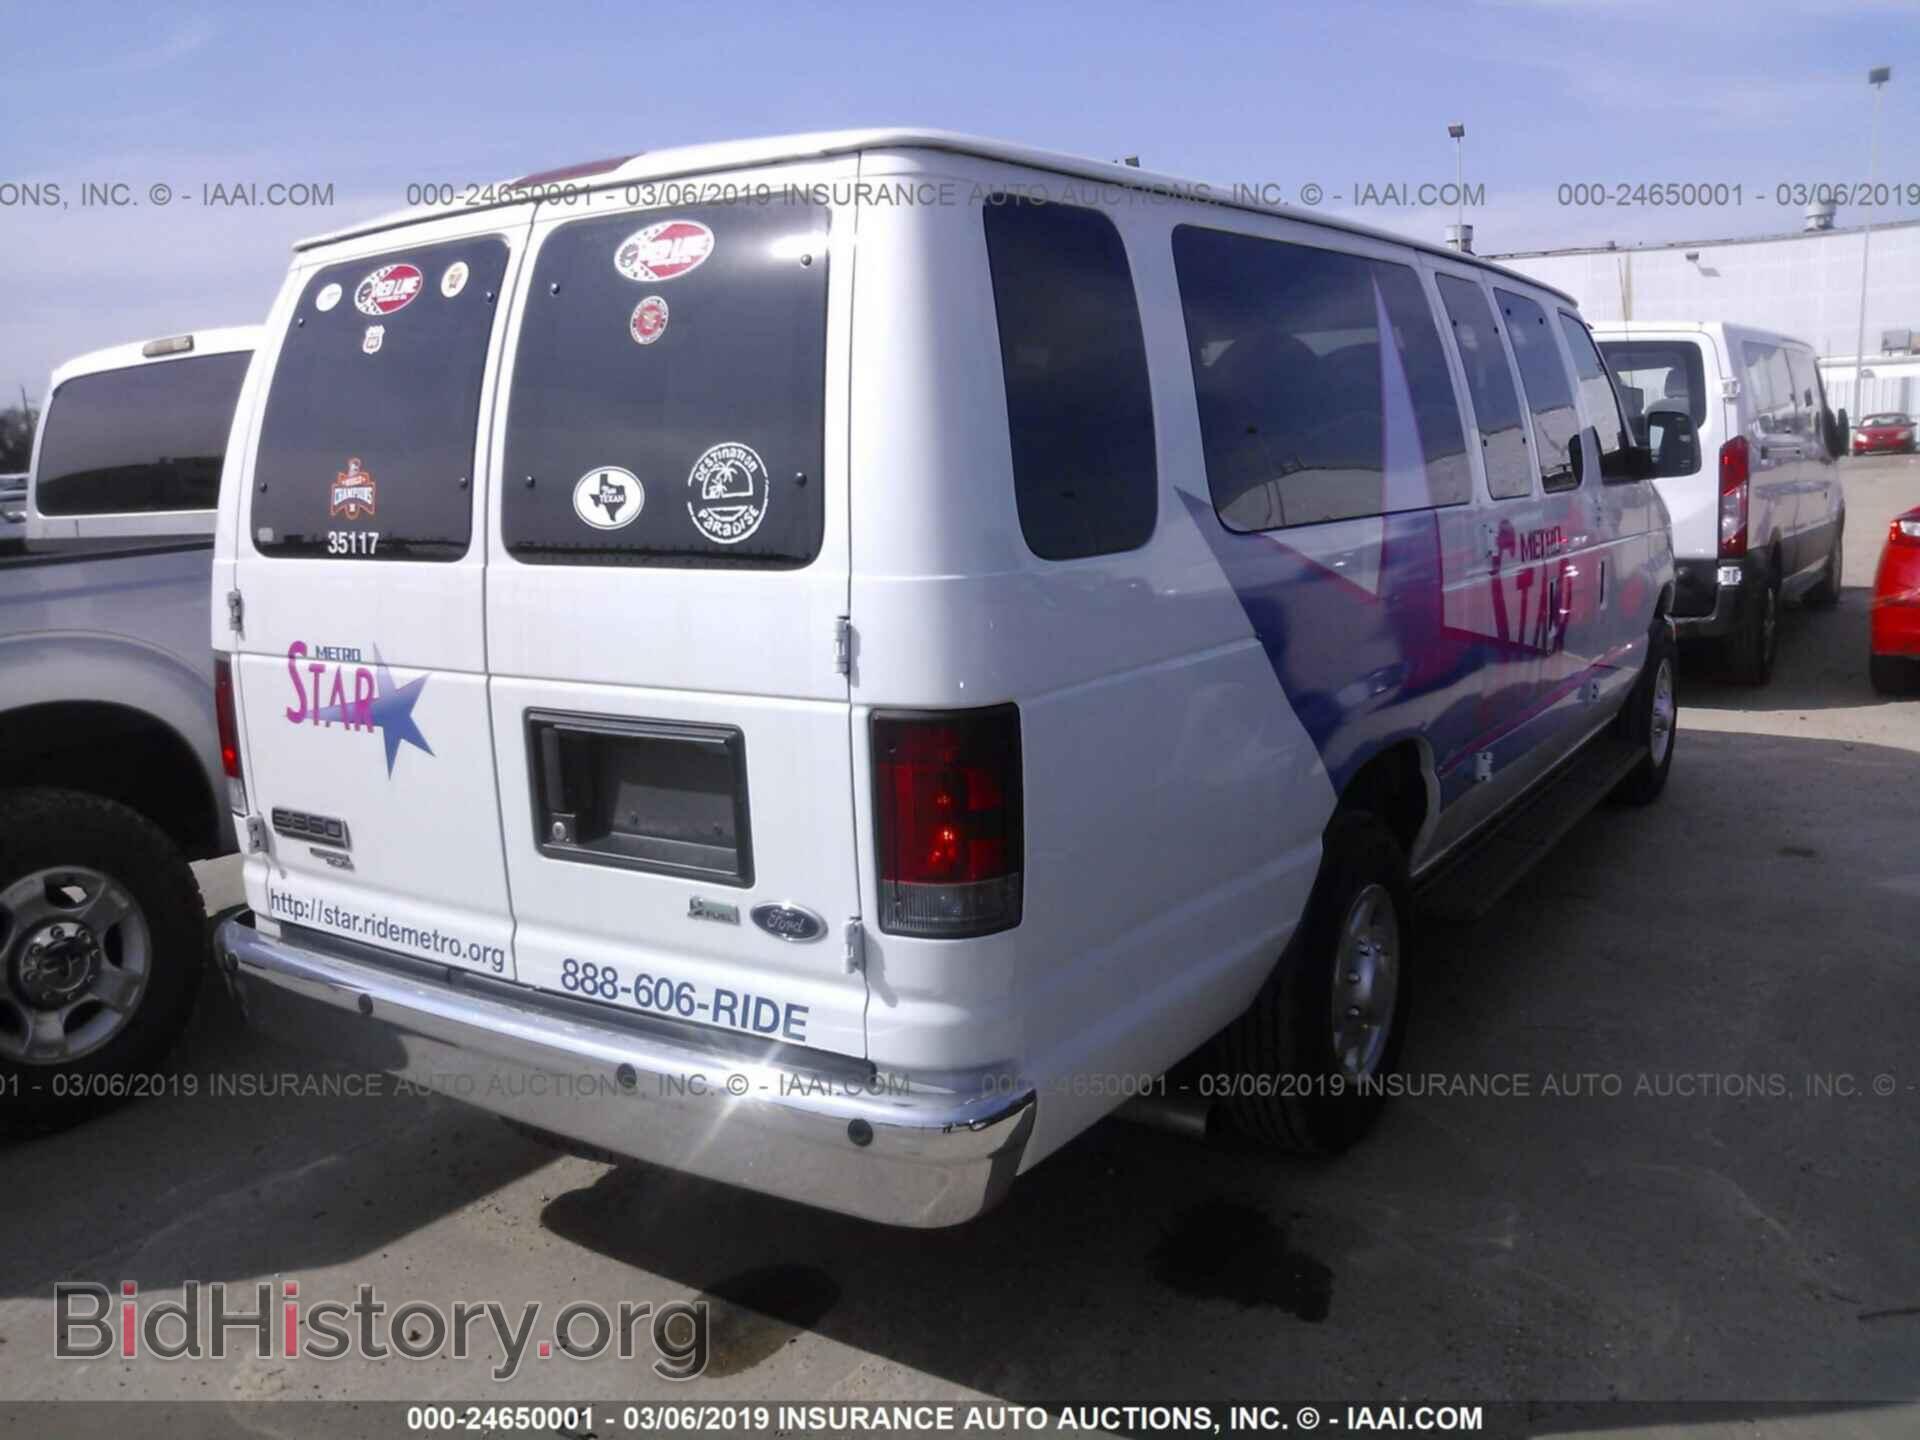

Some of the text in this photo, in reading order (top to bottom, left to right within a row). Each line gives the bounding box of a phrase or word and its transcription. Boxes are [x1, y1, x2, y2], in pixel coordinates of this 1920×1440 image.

[599, 494, 625, 503] TEXAN
[327, 531, 380, 555] 35117
[1519, 526, 1562, 562] METRO
[315, 644, 361, 662] METRO
[286, 640, 375, 734] STAR
[270, 888, 505, 973] http://star.ridemetro.org
[766, 908, 805, 933] Ford
[560, 957, 810, 1042] 888-606-RIDE
